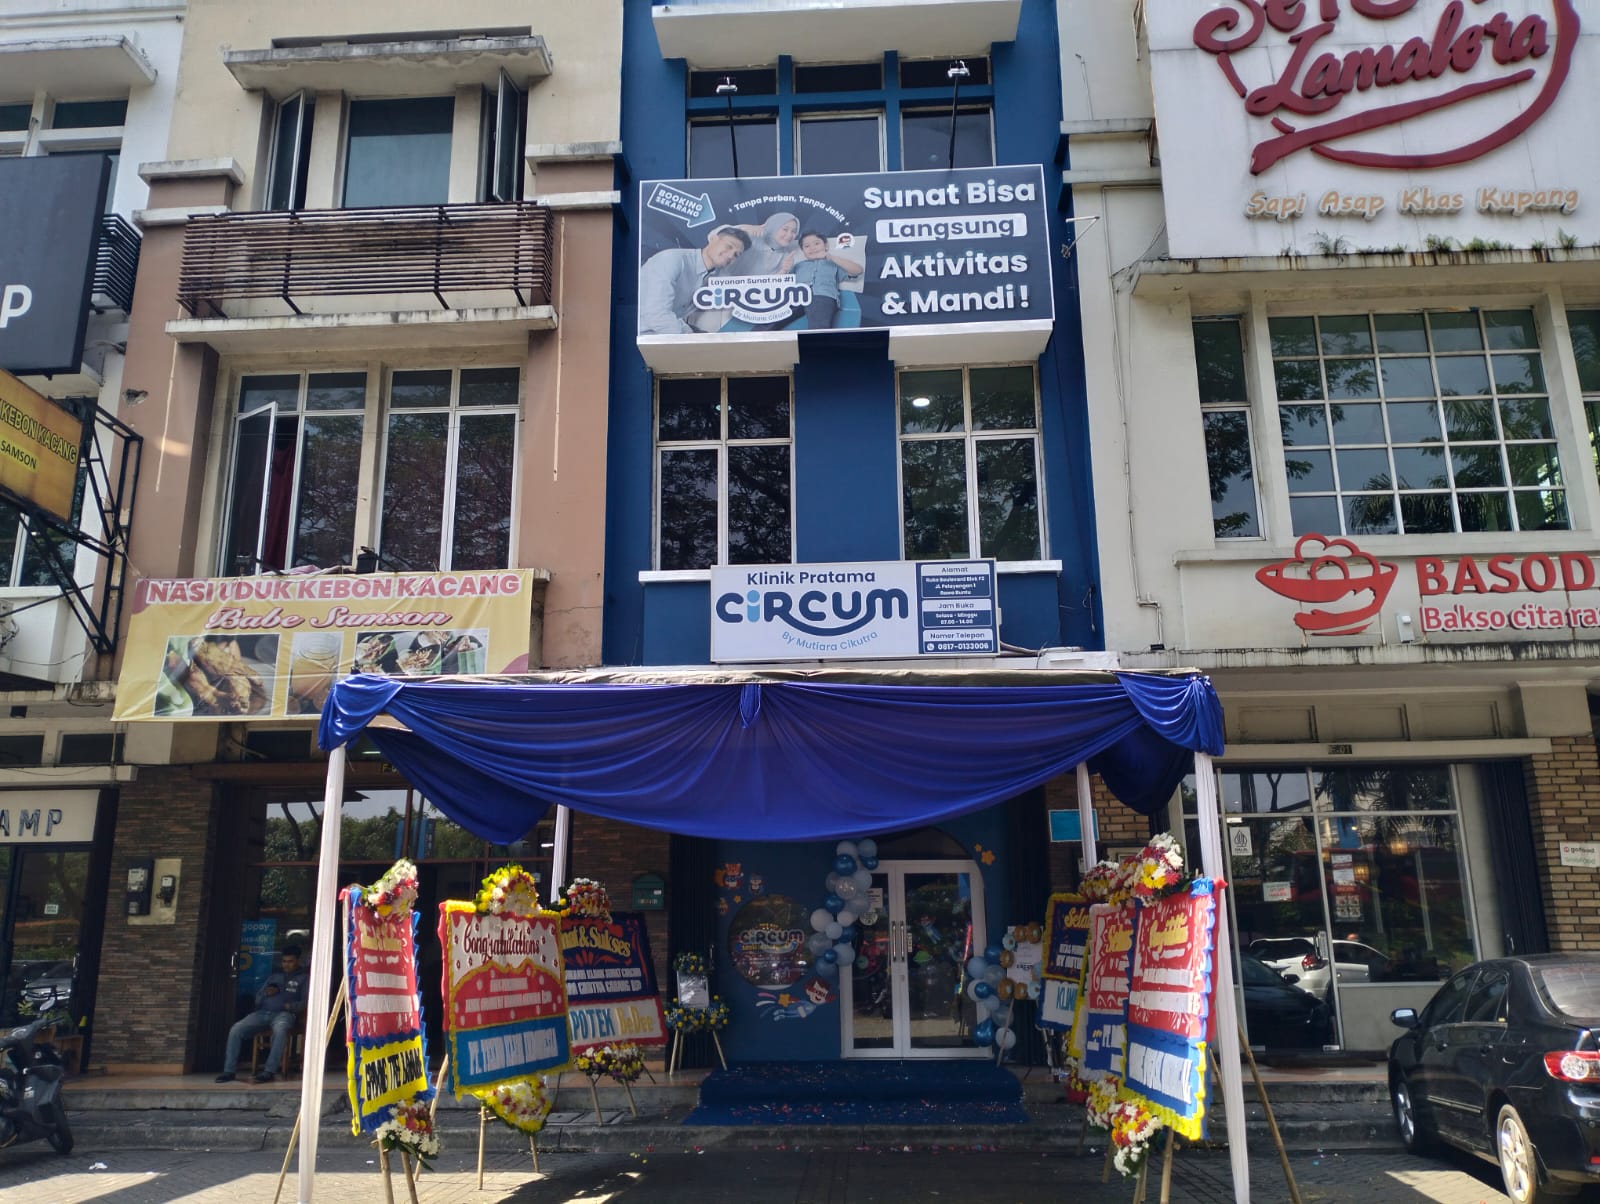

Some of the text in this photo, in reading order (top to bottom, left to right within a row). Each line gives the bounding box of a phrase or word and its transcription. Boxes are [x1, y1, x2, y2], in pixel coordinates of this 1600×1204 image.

[659, 189, 703, 212] BOOKING
[864, 179, 1036, 209] Sunat Bisa
[1246, 187, 1578, 221] Sapi Asap Khas Kupang
[734, 197, 762, 211] Tanpa
[799, 195, 826, 209] Tanpa
[825, 205, 846, 223] Jahit
[888, 218, 1014, 242] Langsung
[880, 250, 1028, 279] Aktivitas
[710, 278, 745, 286] Layanan
[746, 277, 770, 285] Sunat
[882, 291, 908, 315] &
[0, 400, 77, 464] KEBON KACANG
[1, 440, 37, 469] SAMSON
[149, 574, 520, 602] NASI UDUK KEBON KACANG
[747, 571, 875, 585] Klinik Pratama
[205, 605, 452, 630] Babe Samson
[1420, 603, 1600, 632] Bakso cita ra
[782, 631, 879, 651] By Mutiara Cikutra
[464, 923, 540, 963] Congratulations
[589, 926, 631, 958] Sukses
[567, 1007, 616, 1041] POTEK
